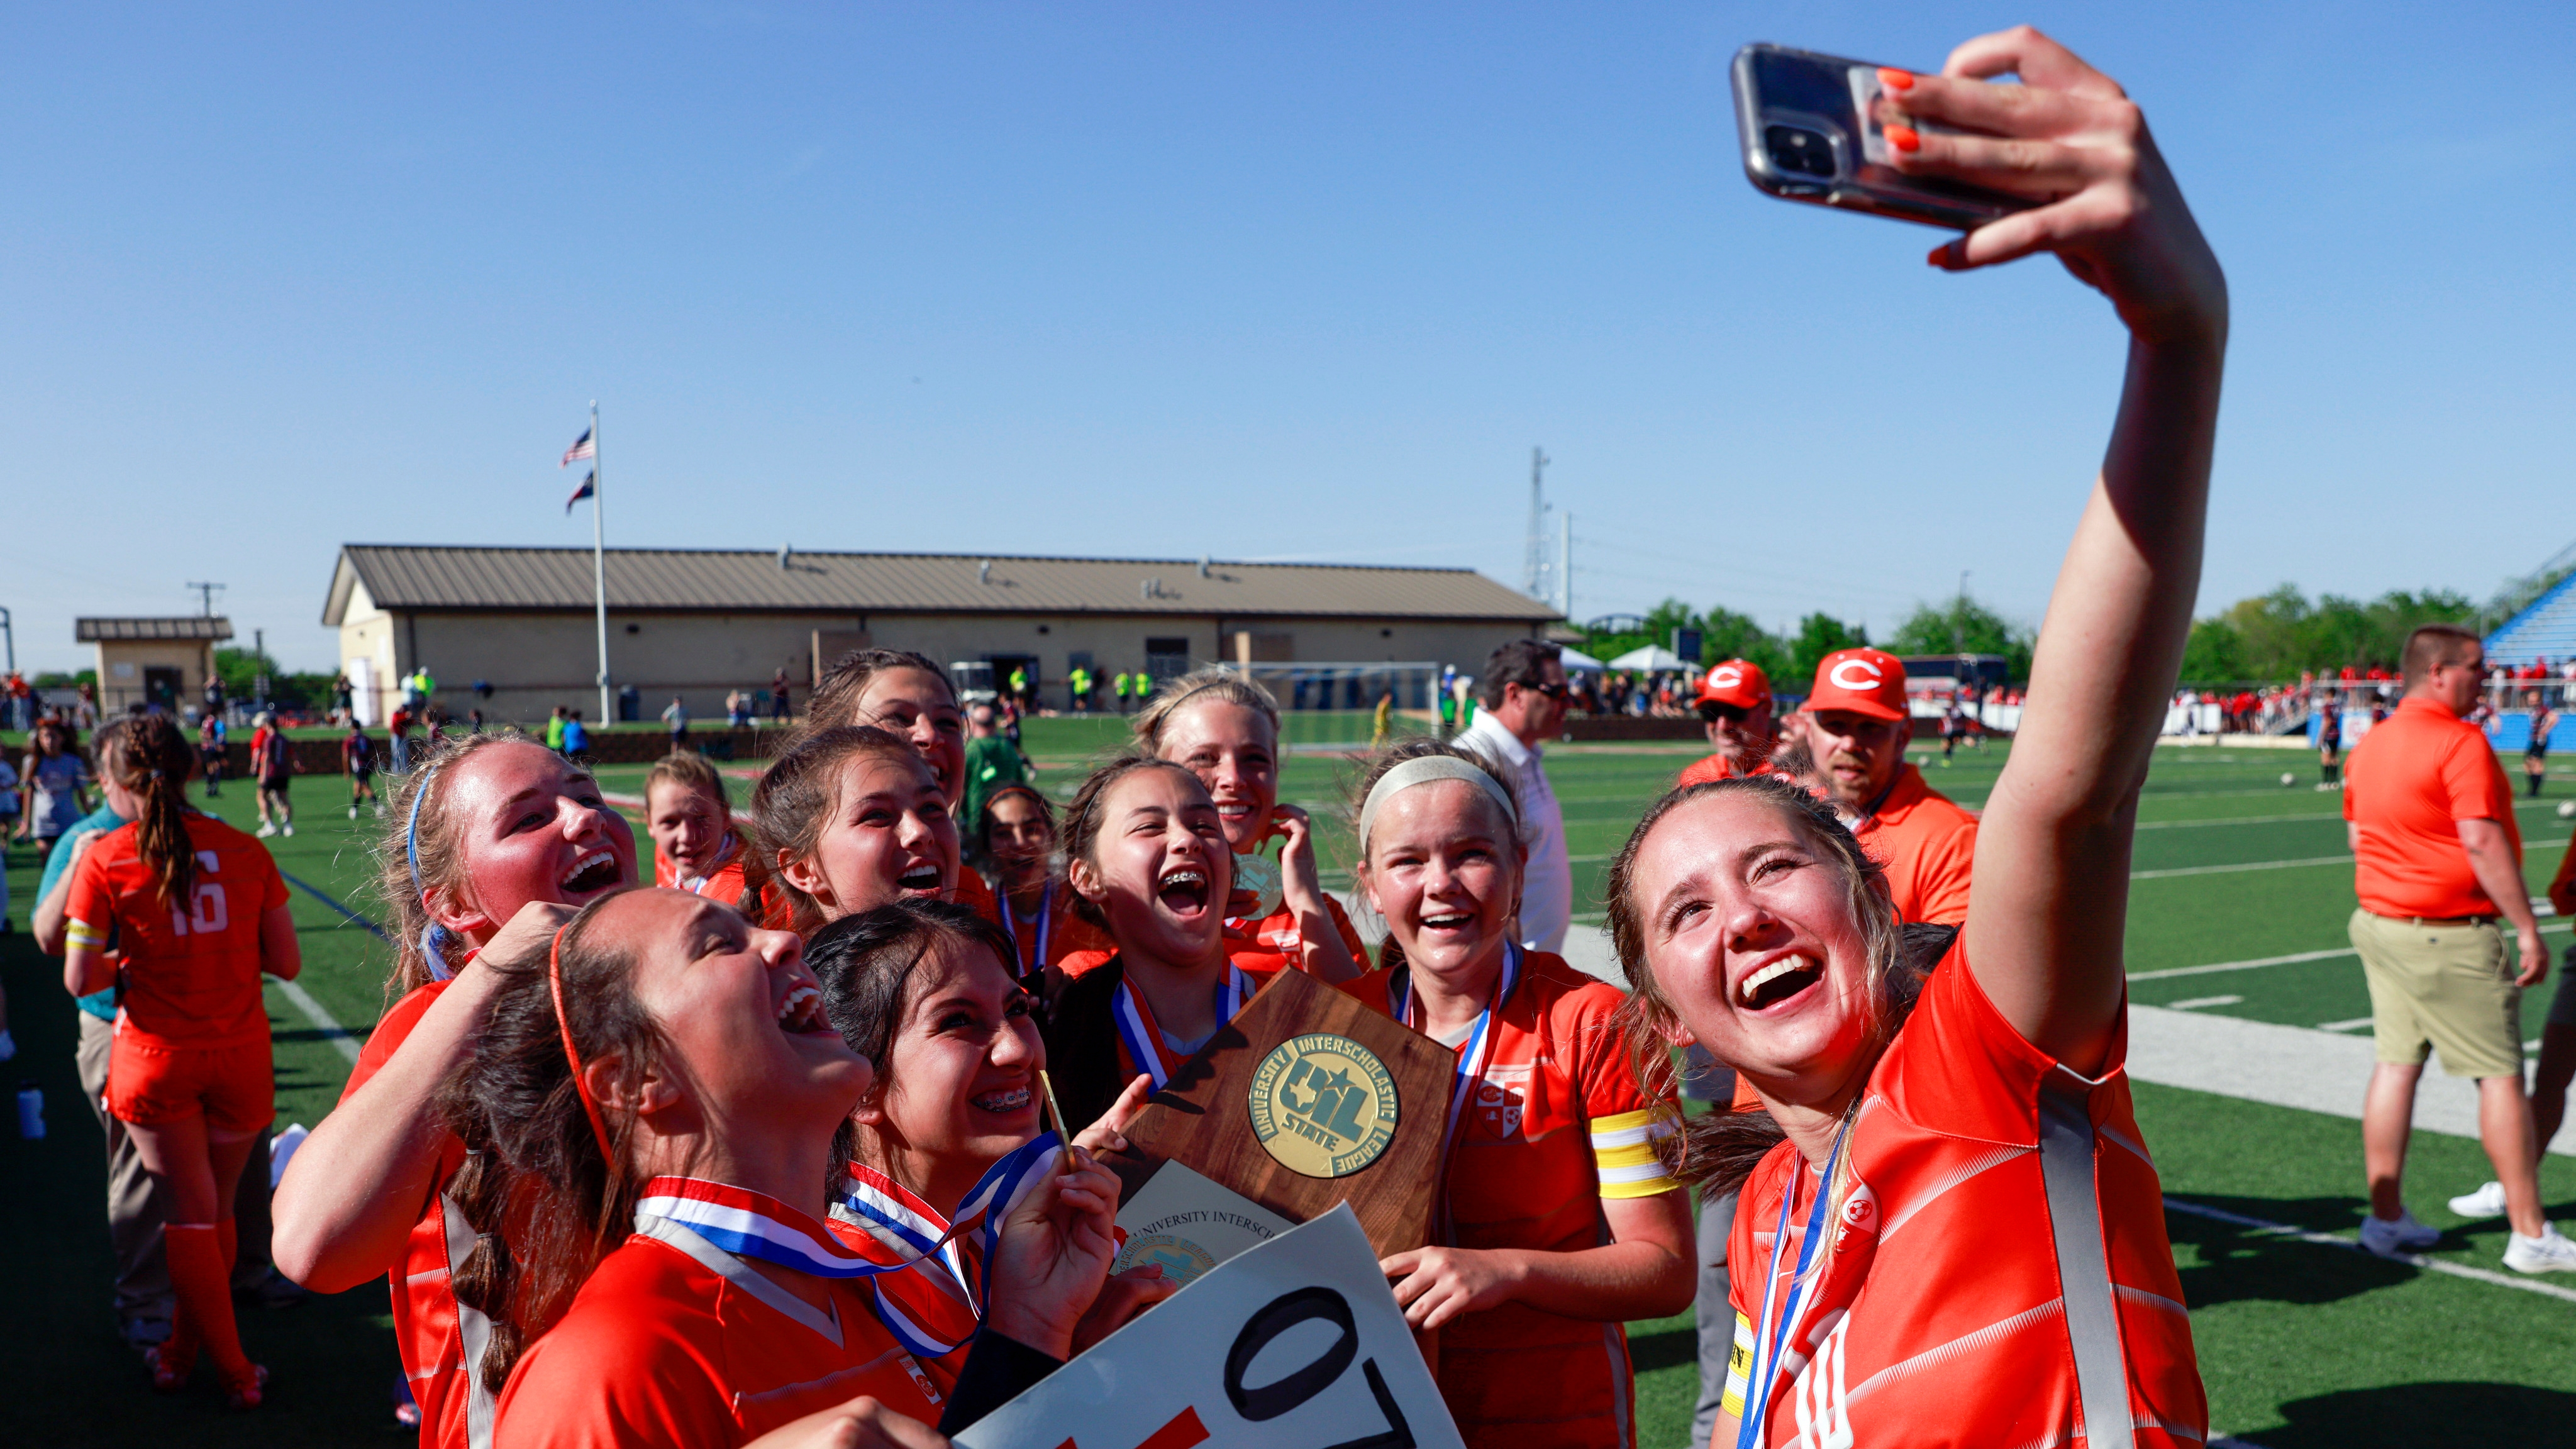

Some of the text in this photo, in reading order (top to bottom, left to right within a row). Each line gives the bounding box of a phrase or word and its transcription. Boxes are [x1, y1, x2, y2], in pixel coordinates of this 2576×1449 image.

[1707, 666, 1742, 689] C
[1829, 658, 1884, 691] C
[1253, 1036, 1396, 1174] UNIVERSITY INTERSCHOLASTIC LEAGUE
[1279, 1112, 1340, 1153] STATE
